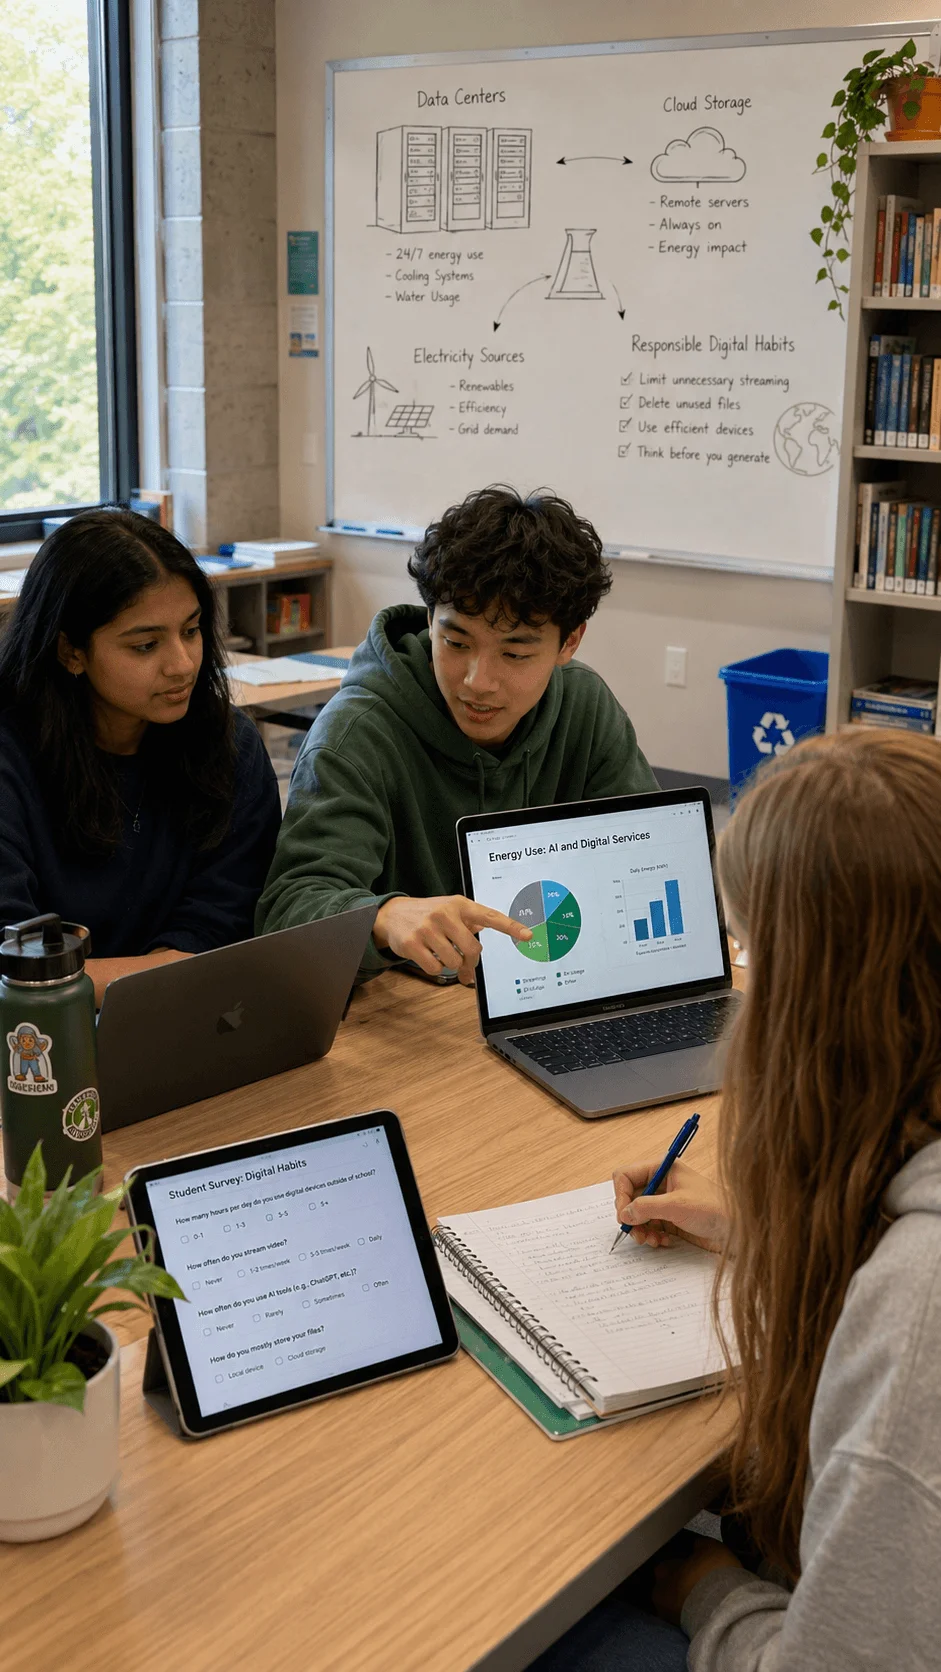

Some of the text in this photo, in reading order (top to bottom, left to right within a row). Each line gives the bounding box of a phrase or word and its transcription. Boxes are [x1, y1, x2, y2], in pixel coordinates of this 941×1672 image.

[417, 87, 506, 108] Data Centers
[663, 95, 753, 116] Cloud Storage
[660, 195, 749, 208] Remote servers
[659, 218, 722, 236] Always on
[396, 247, 484, 264] 24/7 energy use
[658, 240, 748, 259] Energy impact
[395, 269, 474, 286] Cooling Systems
[395, 291, 460, 307] Water Usage
[632, 334, 796, 360] Responsible Digital Habits
[414, 347, 525, 370] Electricity Sources
[459, 380, 514, 392] Renewables
[640, 373, 790, 393] Limit unnecessary streaming
[459, 401, 507, 418] Efficiency
[639, 396, 741, 410] Delete unused files
[458, 423, 519, 435] Grid demand
[638, 420, 754, 437] Use efficient devices
[638, 446, 770, 468] Think before you generate
[489, 831, 650, 862] Energy Use: AI and Digital Services
[169, 1158, 307, 1200] Student Survey: Digital Habits
[176, 1217, 191, 1225] How
[191, 1212, 209, 1223] many
[210, 1206, 229, 1217] hours
[230, 1205, 240, 1214] per
[253, 1198, 262, 1207] do
[262, 1196, 274, 1205] you
[285, 1186, 304, 1198] digital
[305, 1182, 326, 1194] devices
[327, 1178, 348, 1189] outside
[348, 1175, 354, 1183] of
[355, 1168, 376, 1181] school?
[368, 1234, 383, 1244] Daily
[187, 1239, 288, 1271] How often do you stream video?
[205, 1276, 224, 1286] Never
[198, 1308, 214, 1318] How
[214, 1303, 232, 1313] often
[233, 1300, 242, 1309] do
[242, 1297, 255, 1307] you
[255, 1293, 268, 1302] use
[268, 1290, 275, 1298] AI
[314, 1291, 345, 1306] Sometimes
[265, 1309, 284, 1320] Rarely
[216, 1322, 235, 1333] Never
[210, 1325, 325, 1364] How do you mostly store your files?
[287, 1345, 326, 1362] Cloud storage
[228, 1363, 265, 1380] Local device
